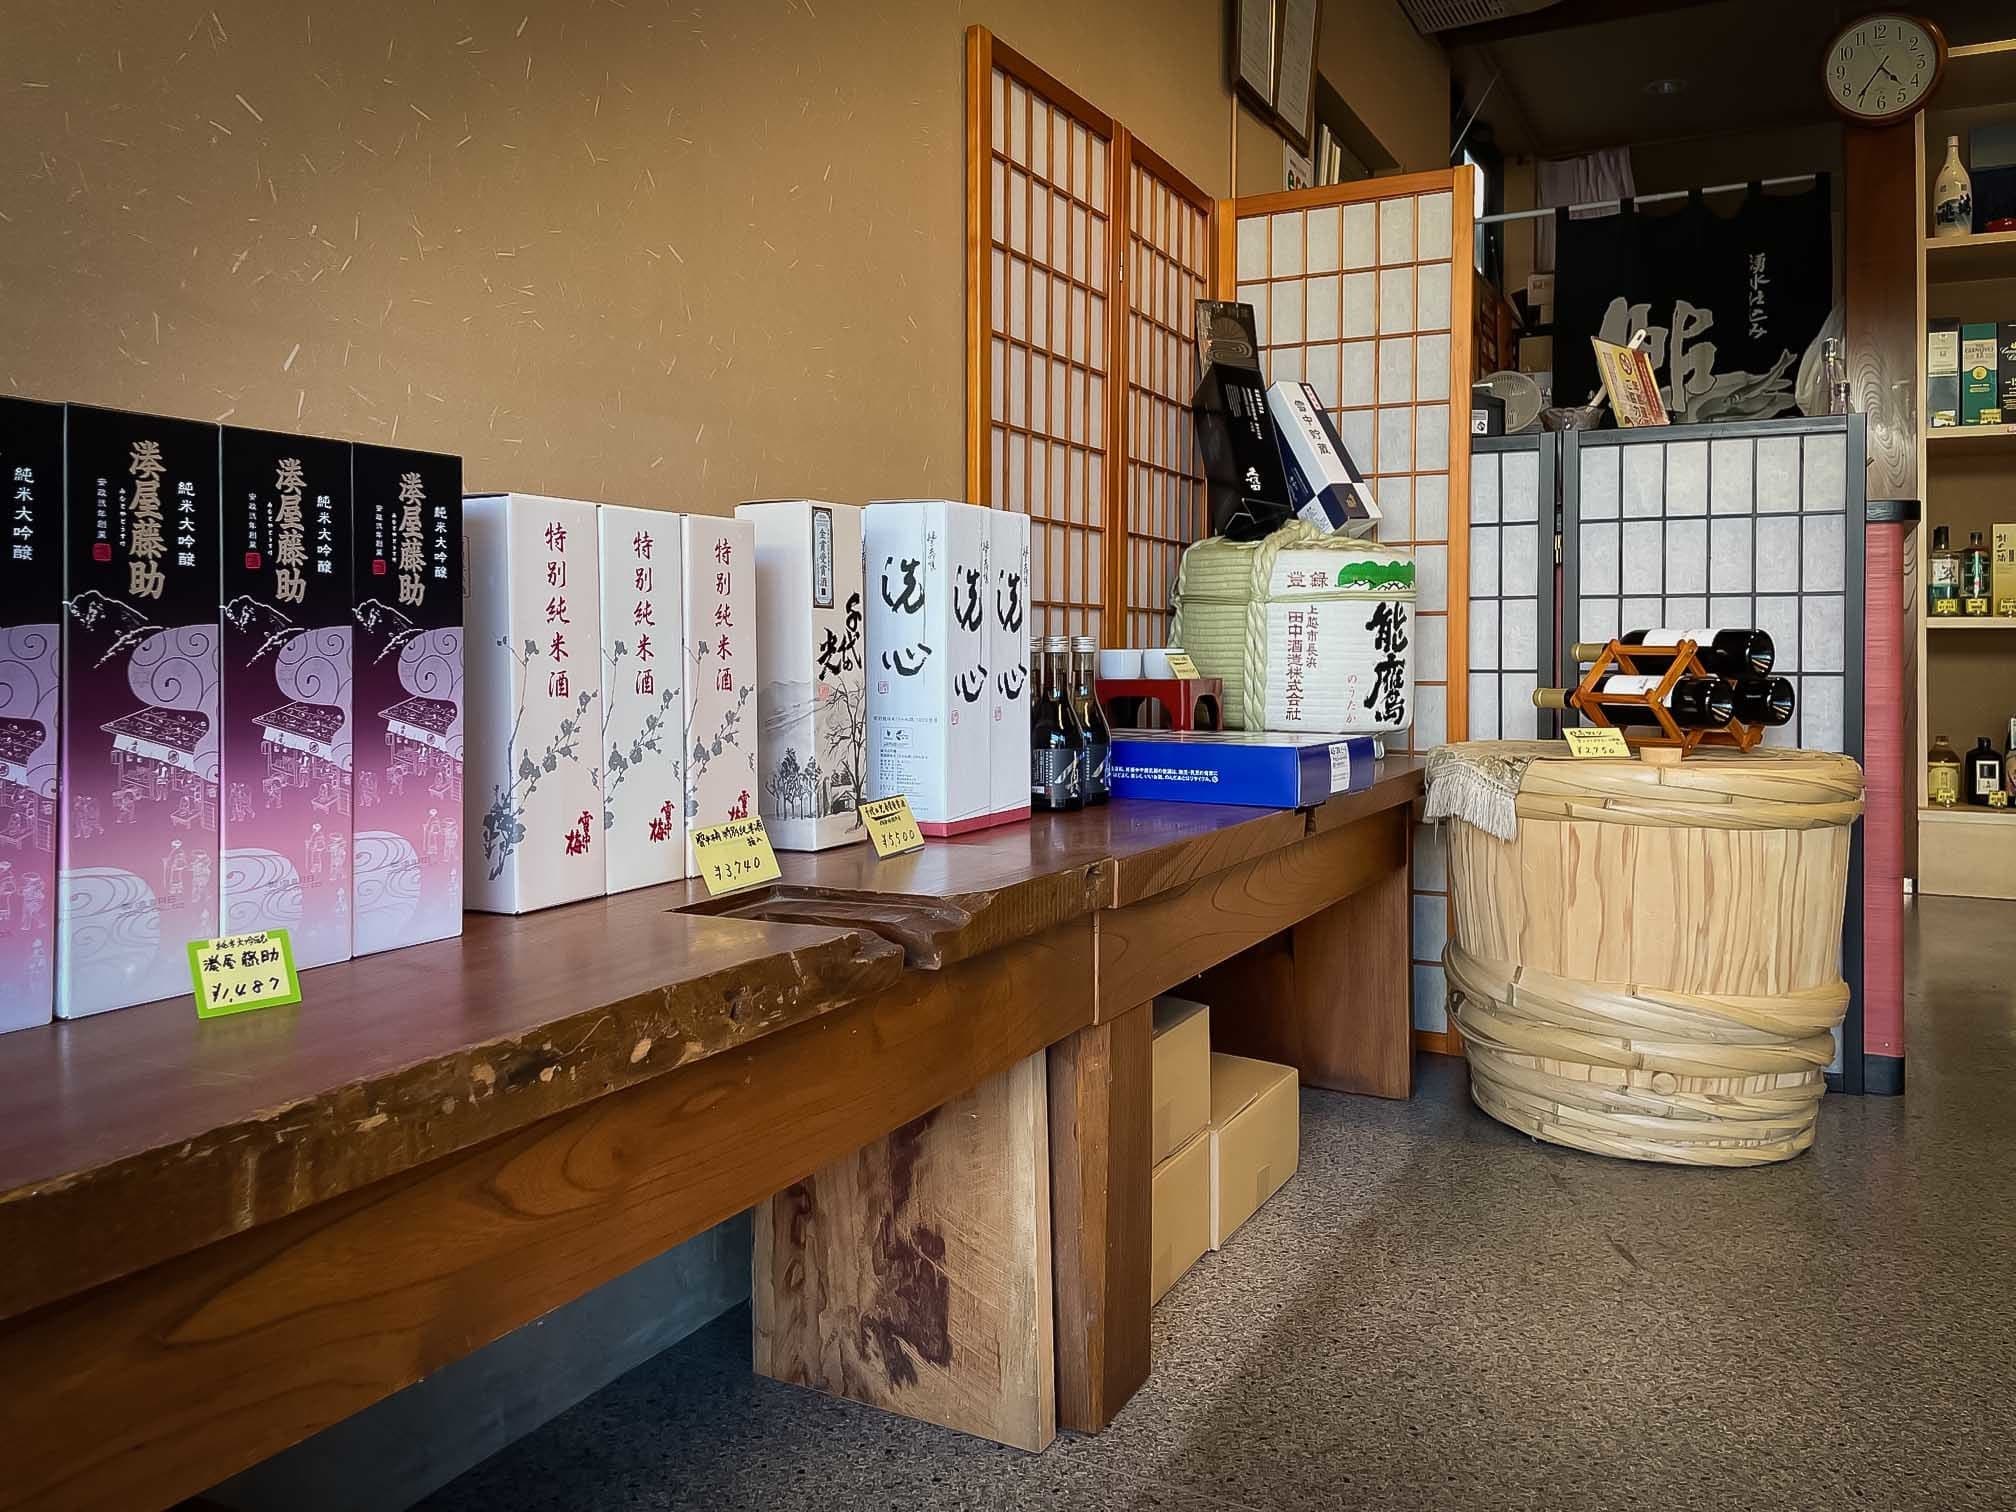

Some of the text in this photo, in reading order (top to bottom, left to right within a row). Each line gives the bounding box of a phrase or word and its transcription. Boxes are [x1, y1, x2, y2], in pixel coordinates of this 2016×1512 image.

[1840, 47, 1854, 61] 10
[1855, 31, 1865, 46] 11
[1873, 24, 1887, 40] 12
[1897, 25, 1902, 41] 1
[1909, 36, 1919, 51] 2
[1916, 54, 1926, 69] 3
[1836, 65, 1846, 80] 9
[1842, 83, 1851, 97] 8
[1876, 95, 1886, 110] 6
[1896, 87, 1906, 103] 5
[1910, 73, 1920, 87] 4
[12, 466, 35, 561] 純米大吟醸
[128, 439, 168, 600] 湊屋藤助
[177, 481, 196, 567] 純米大吟醸
[275, 457, 309, 604] 湊屋藤助
[316, 495, 333, 574] 純米大吟醸
[398, 471, 427, 607] 湊屋藤助
[433, 506, 448, 579] 純米大吟醸
[544, 521, 571, 699] 特別純米酒
[1287, 571, 1329, 588] 登録
[633, 530, 656, 696] 特別純米酒
[714, 537, 734, 692] 特別純米酒
[881, 556, 933, 677] 洗心
[953, 564, 989, 703] 洗心
[996, 569, 1028, 701] 洗心
[1305, 605, 1319, 669] 上越市長浜
[1286, 611, 1304, 721] 田中酒造株式会社
[1363, 601, 1409, 726] 能鷹
[564, 810, 594, 856] 雪中梅
[649, 800, 675, 843] 雪中梅
[713, 856, 761, 881] ¥3,740
